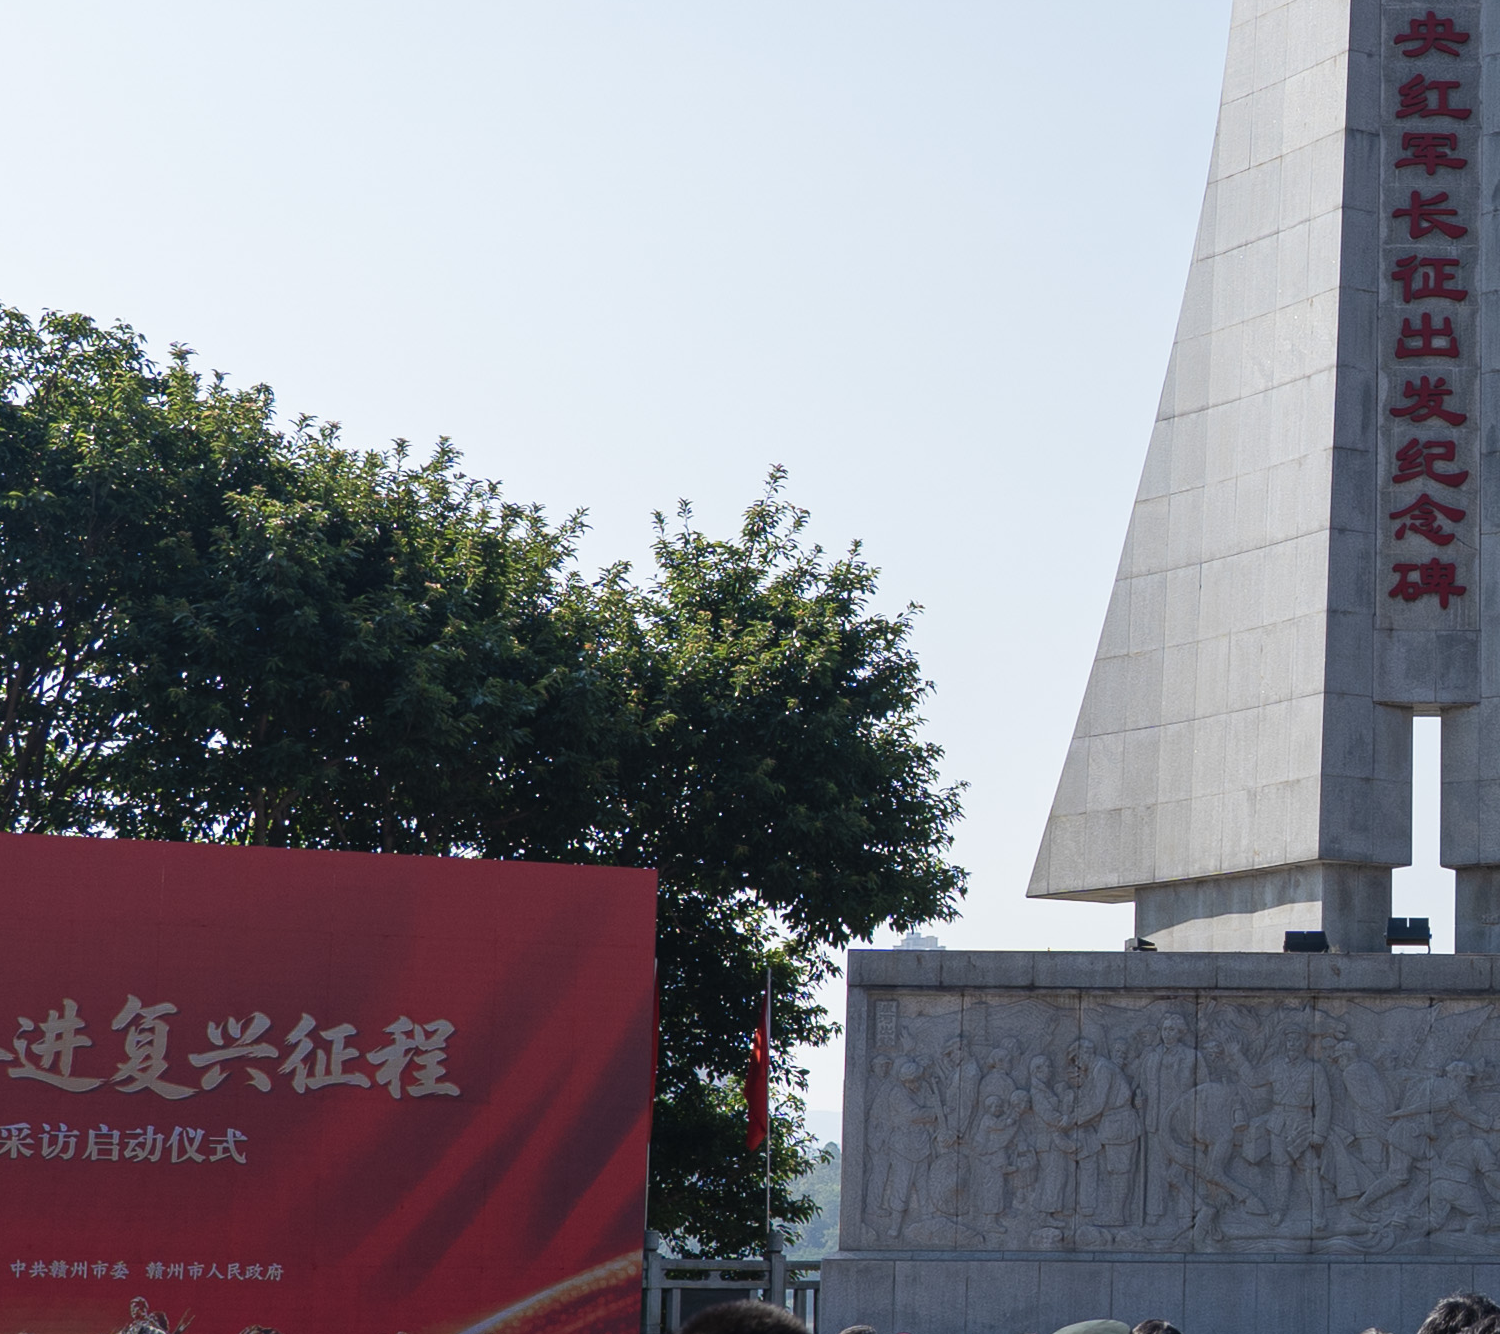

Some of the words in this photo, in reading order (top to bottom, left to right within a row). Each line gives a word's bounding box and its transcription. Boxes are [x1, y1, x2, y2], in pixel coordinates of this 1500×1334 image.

[10, 1260, 130, 1280] 中共赣州市委
[145, 1261, 285, 1282] 赣州市人民政府
